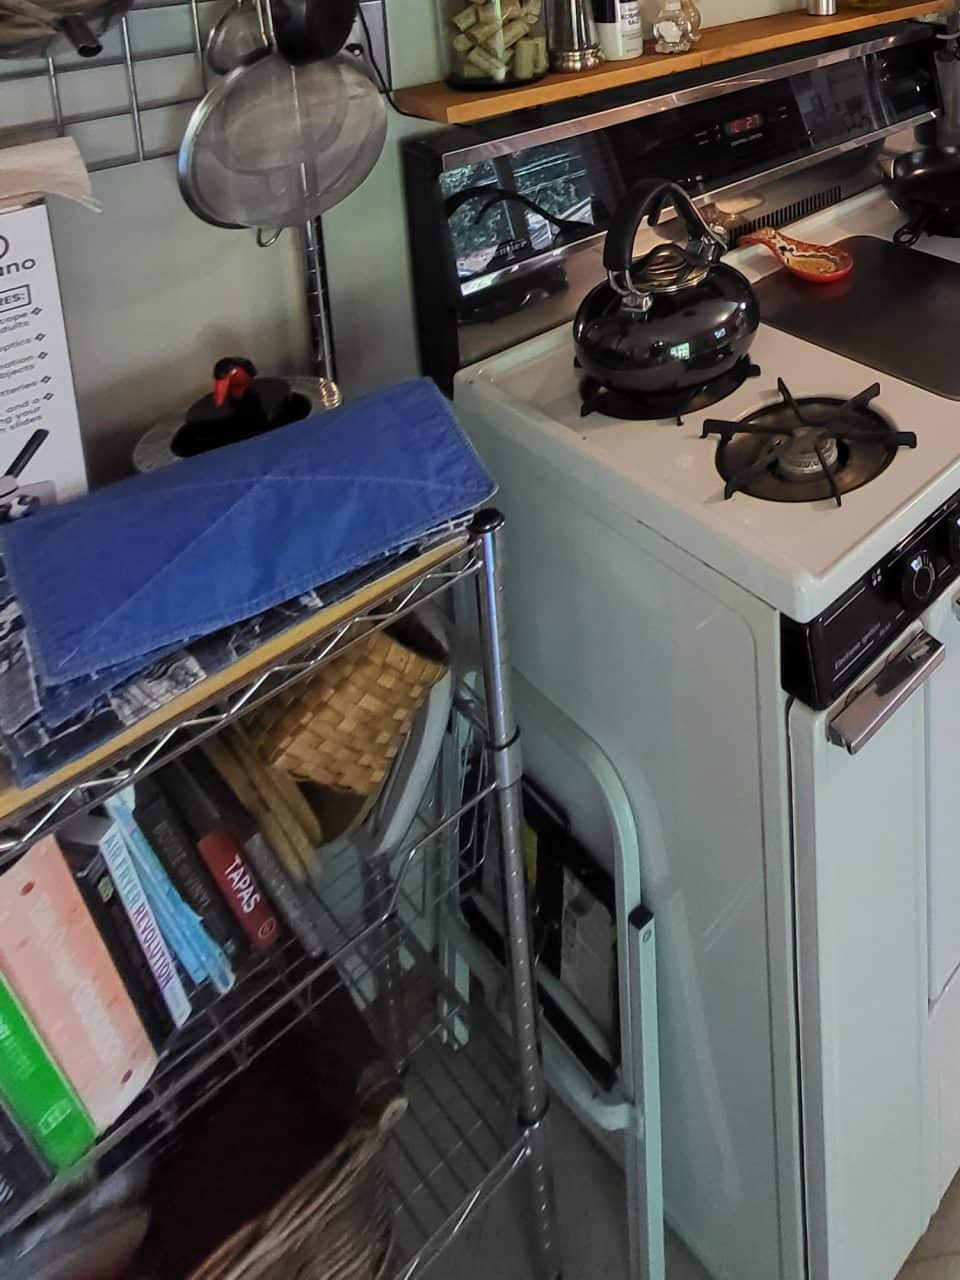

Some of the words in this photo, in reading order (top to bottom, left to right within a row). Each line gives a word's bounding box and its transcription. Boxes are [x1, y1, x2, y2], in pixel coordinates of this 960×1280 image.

[104, 833, 126, 863] AIR
[115, 856, 143, 909] FRYER
[133, 902, 174, 990] REVOLUTION
[225, 853, 260, 913] TAPAS
